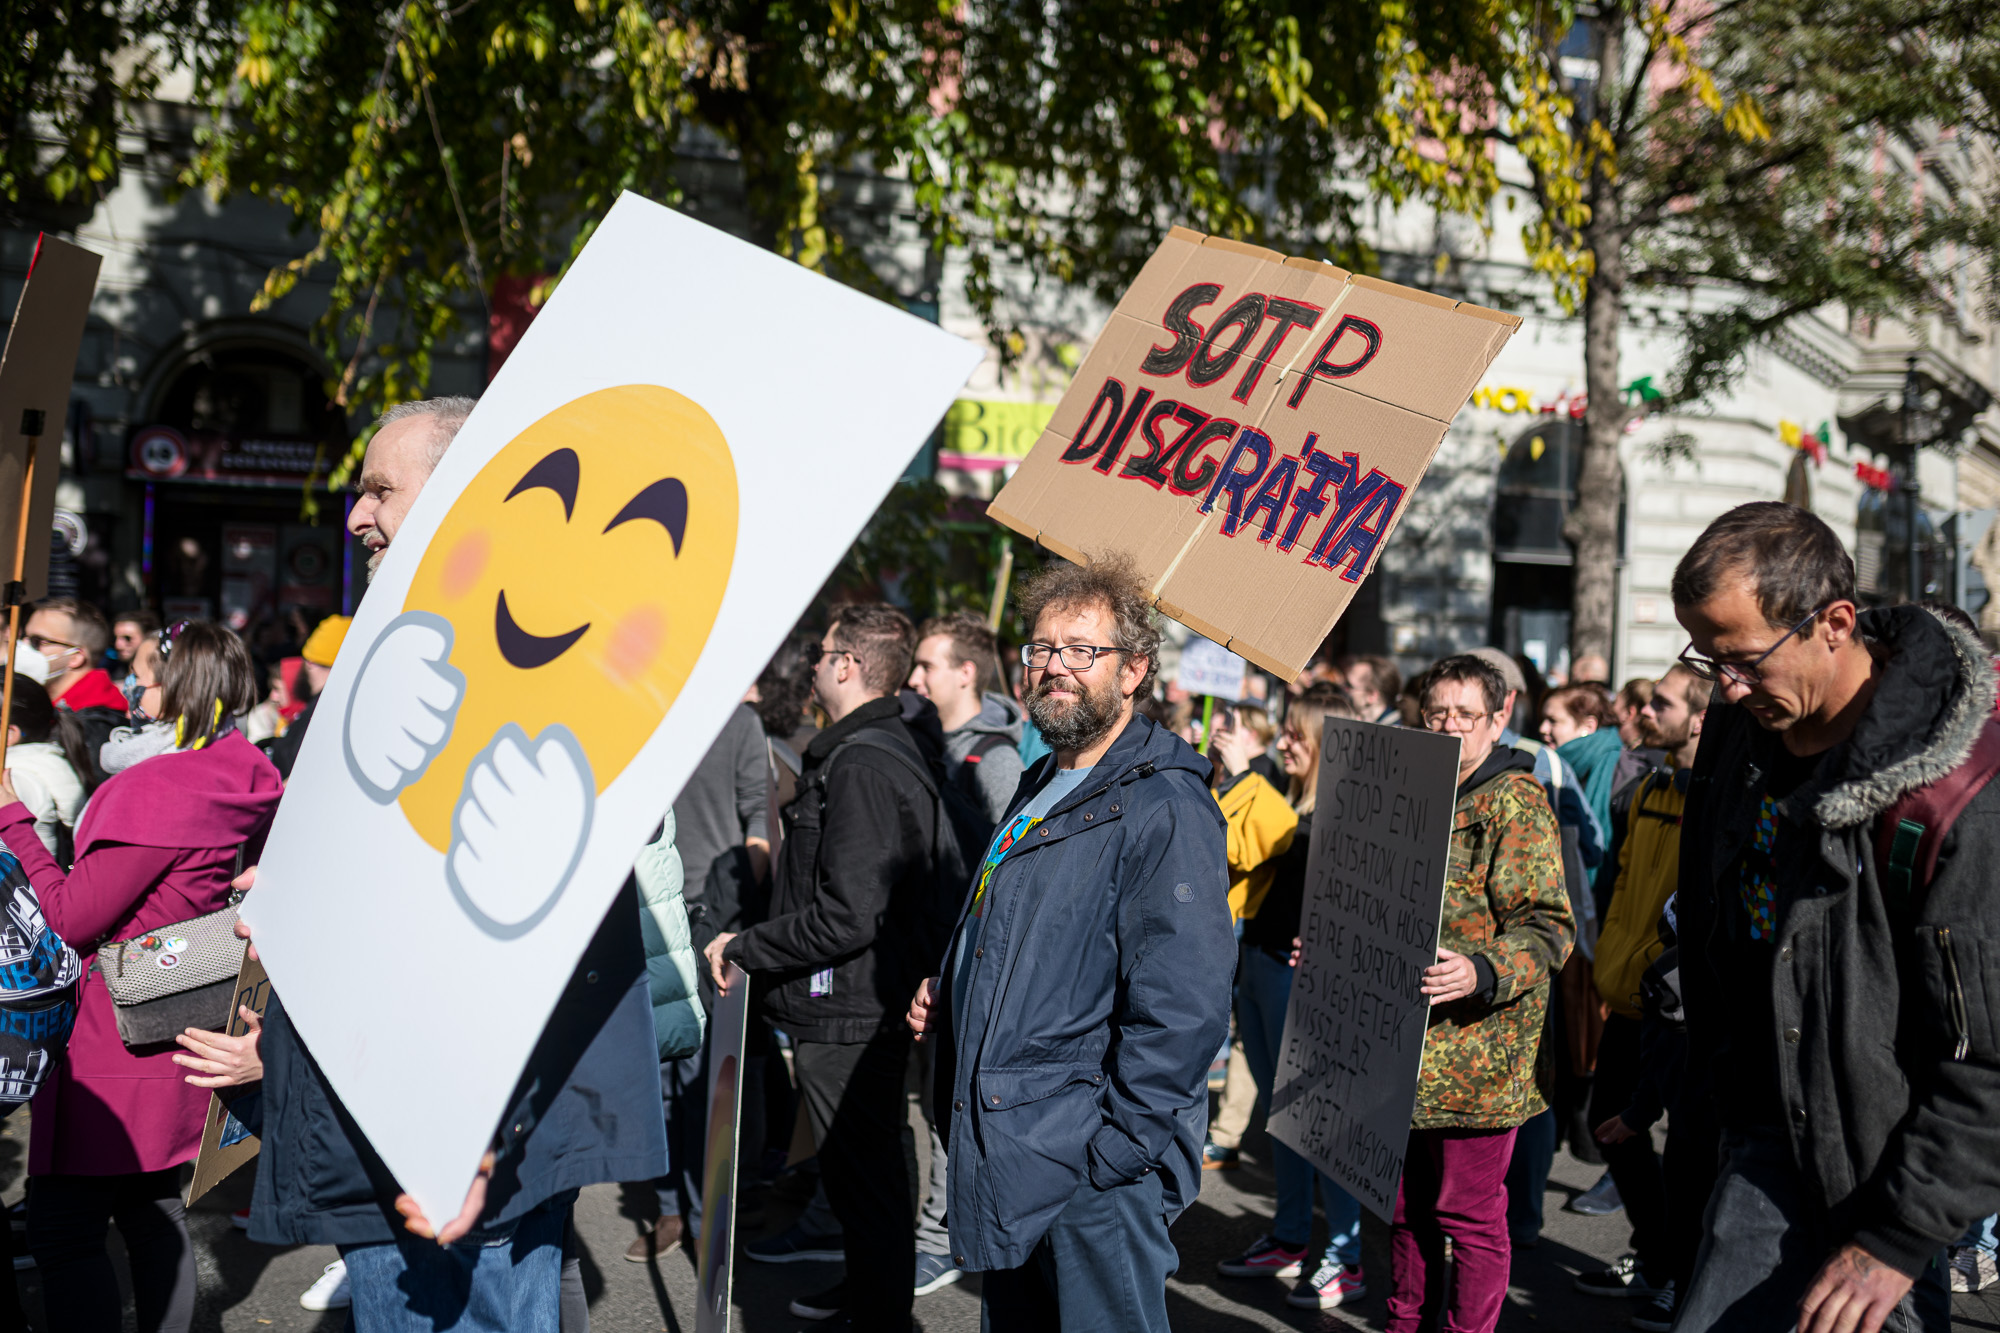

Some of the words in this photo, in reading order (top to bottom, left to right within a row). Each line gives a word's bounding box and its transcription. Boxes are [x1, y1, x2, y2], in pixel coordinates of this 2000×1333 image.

[1139, 282, 1325, 406] SOT
[1287, 313, 1383, 410] P
[1333, 779, 1382, 826] STOP
[1313, 867, 1390, 935] ZÁRJATOK
[1396, 908, 1436, 954] HÚSZ
[1401, 856, 1431, 907] LE!
[1307, 903, 1345, 959] ÉVRE
[1298, 947, 1319, 994] ÉS
[1295, 999, 1343, 1053] VISSZA
[1350, 1034, 1371, 1076] AZ
[1287, 1038, 1357, 1103] ELLOPOTT
[1287, 1078, 1345, 1148] NEMZETI
[1348, 1115, 1403, 1188] VAGYONT
